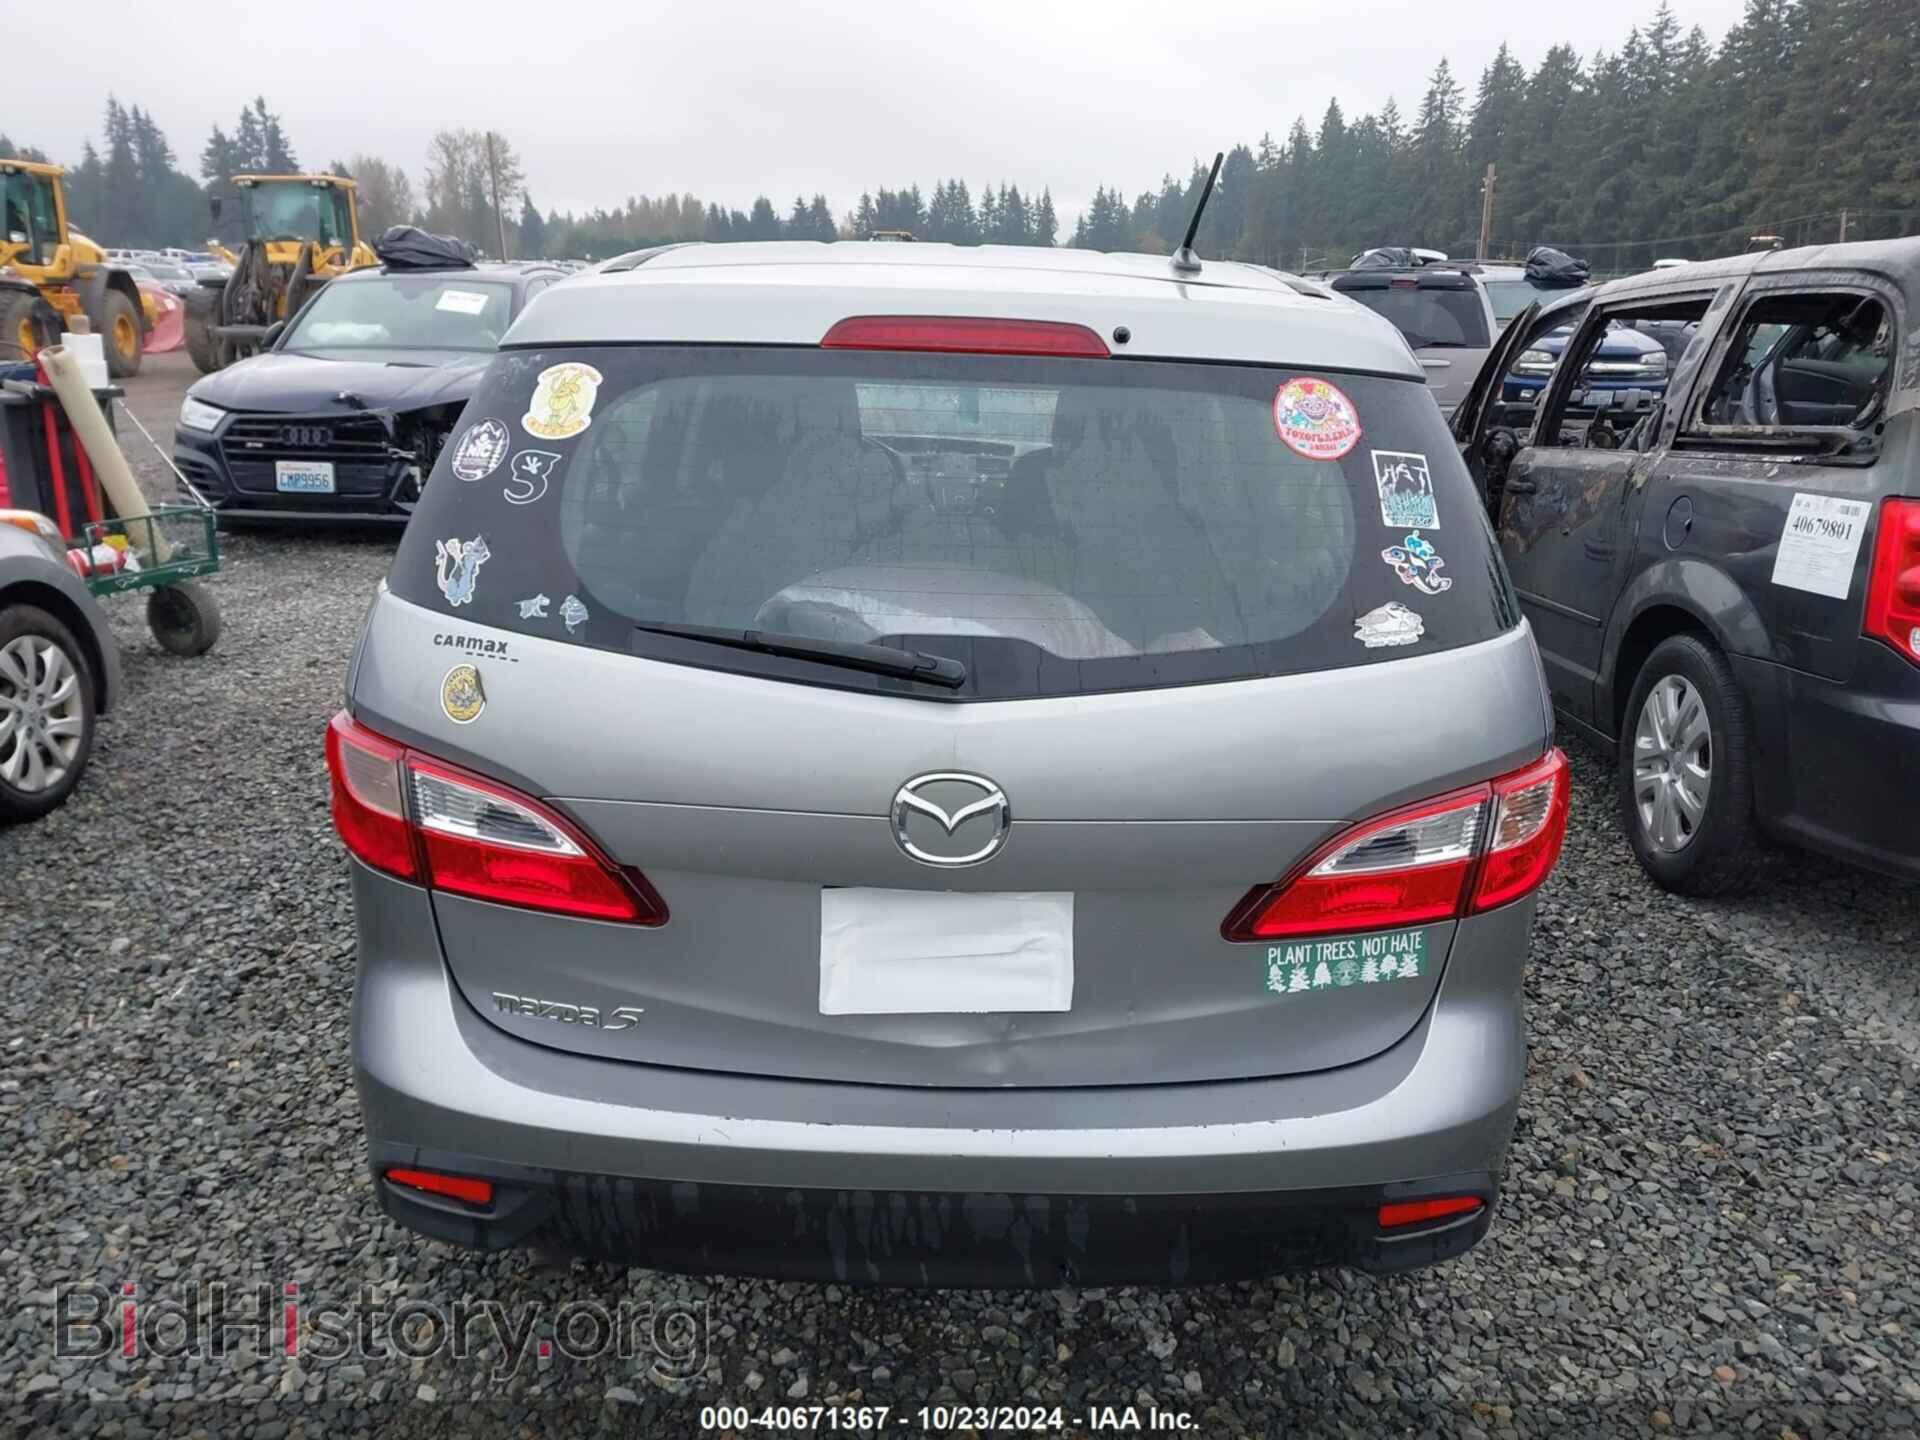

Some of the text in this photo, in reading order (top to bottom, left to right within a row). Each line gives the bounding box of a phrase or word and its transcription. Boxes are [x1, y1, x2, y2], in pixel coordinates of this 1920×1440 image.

[1793, 516, 1852, 540] 40679801
[1268, 944, 1312, 966] PLANT
[1362, 936, 1389, 957] NOT
[1391, 931, 1423, 953] HATE
